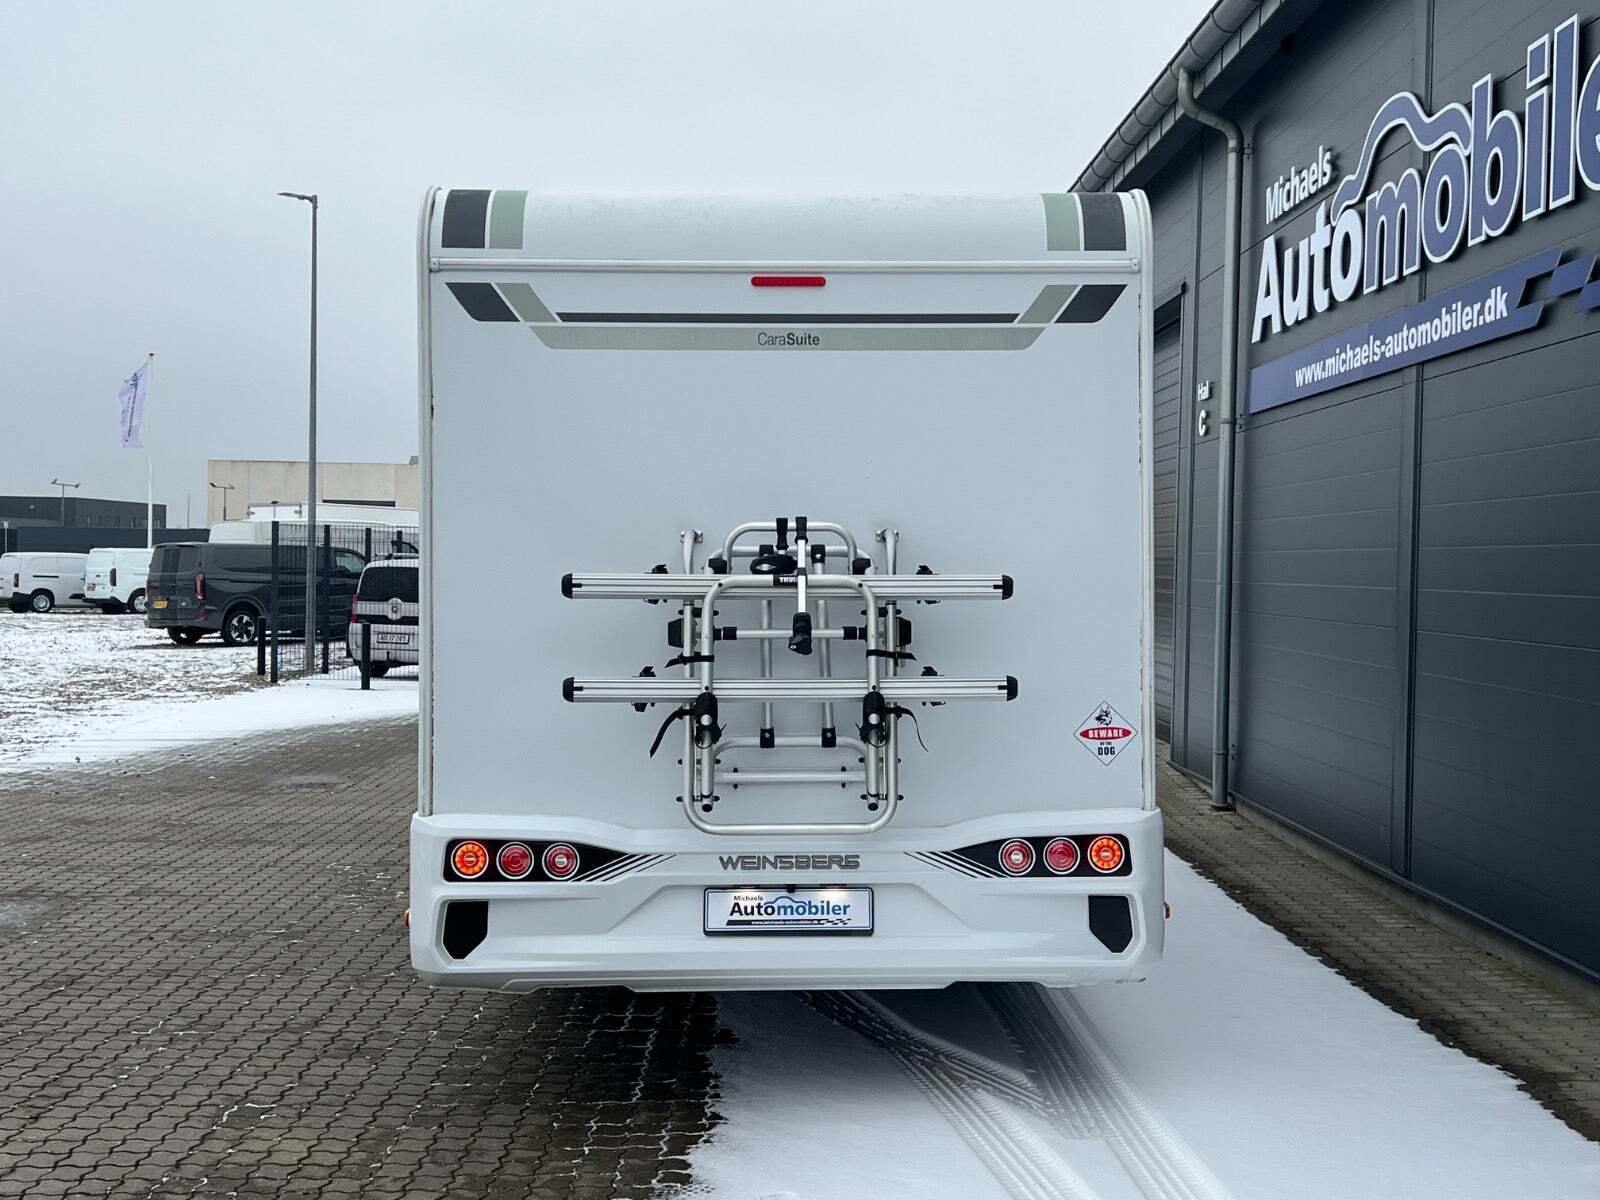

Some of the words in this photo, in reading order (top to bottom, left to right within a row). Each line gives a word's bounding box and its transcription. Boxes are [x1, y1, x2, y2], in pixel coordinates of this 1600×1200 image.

[1265, 144, 1333, 225] Michaels
[757, 332, 820, 346] CaraSuite
[1295, 286, 1509, 388] www.michaels-automobiler.dk
[1198, 409, 1206, 437] C
[1088, 729, 1124, 738] BEWARE
[1097, 746, 1116, 756] DOG
[719, 854, 861, 871] WEINSBERG
[729, 900, 851, 917] Automobiler
